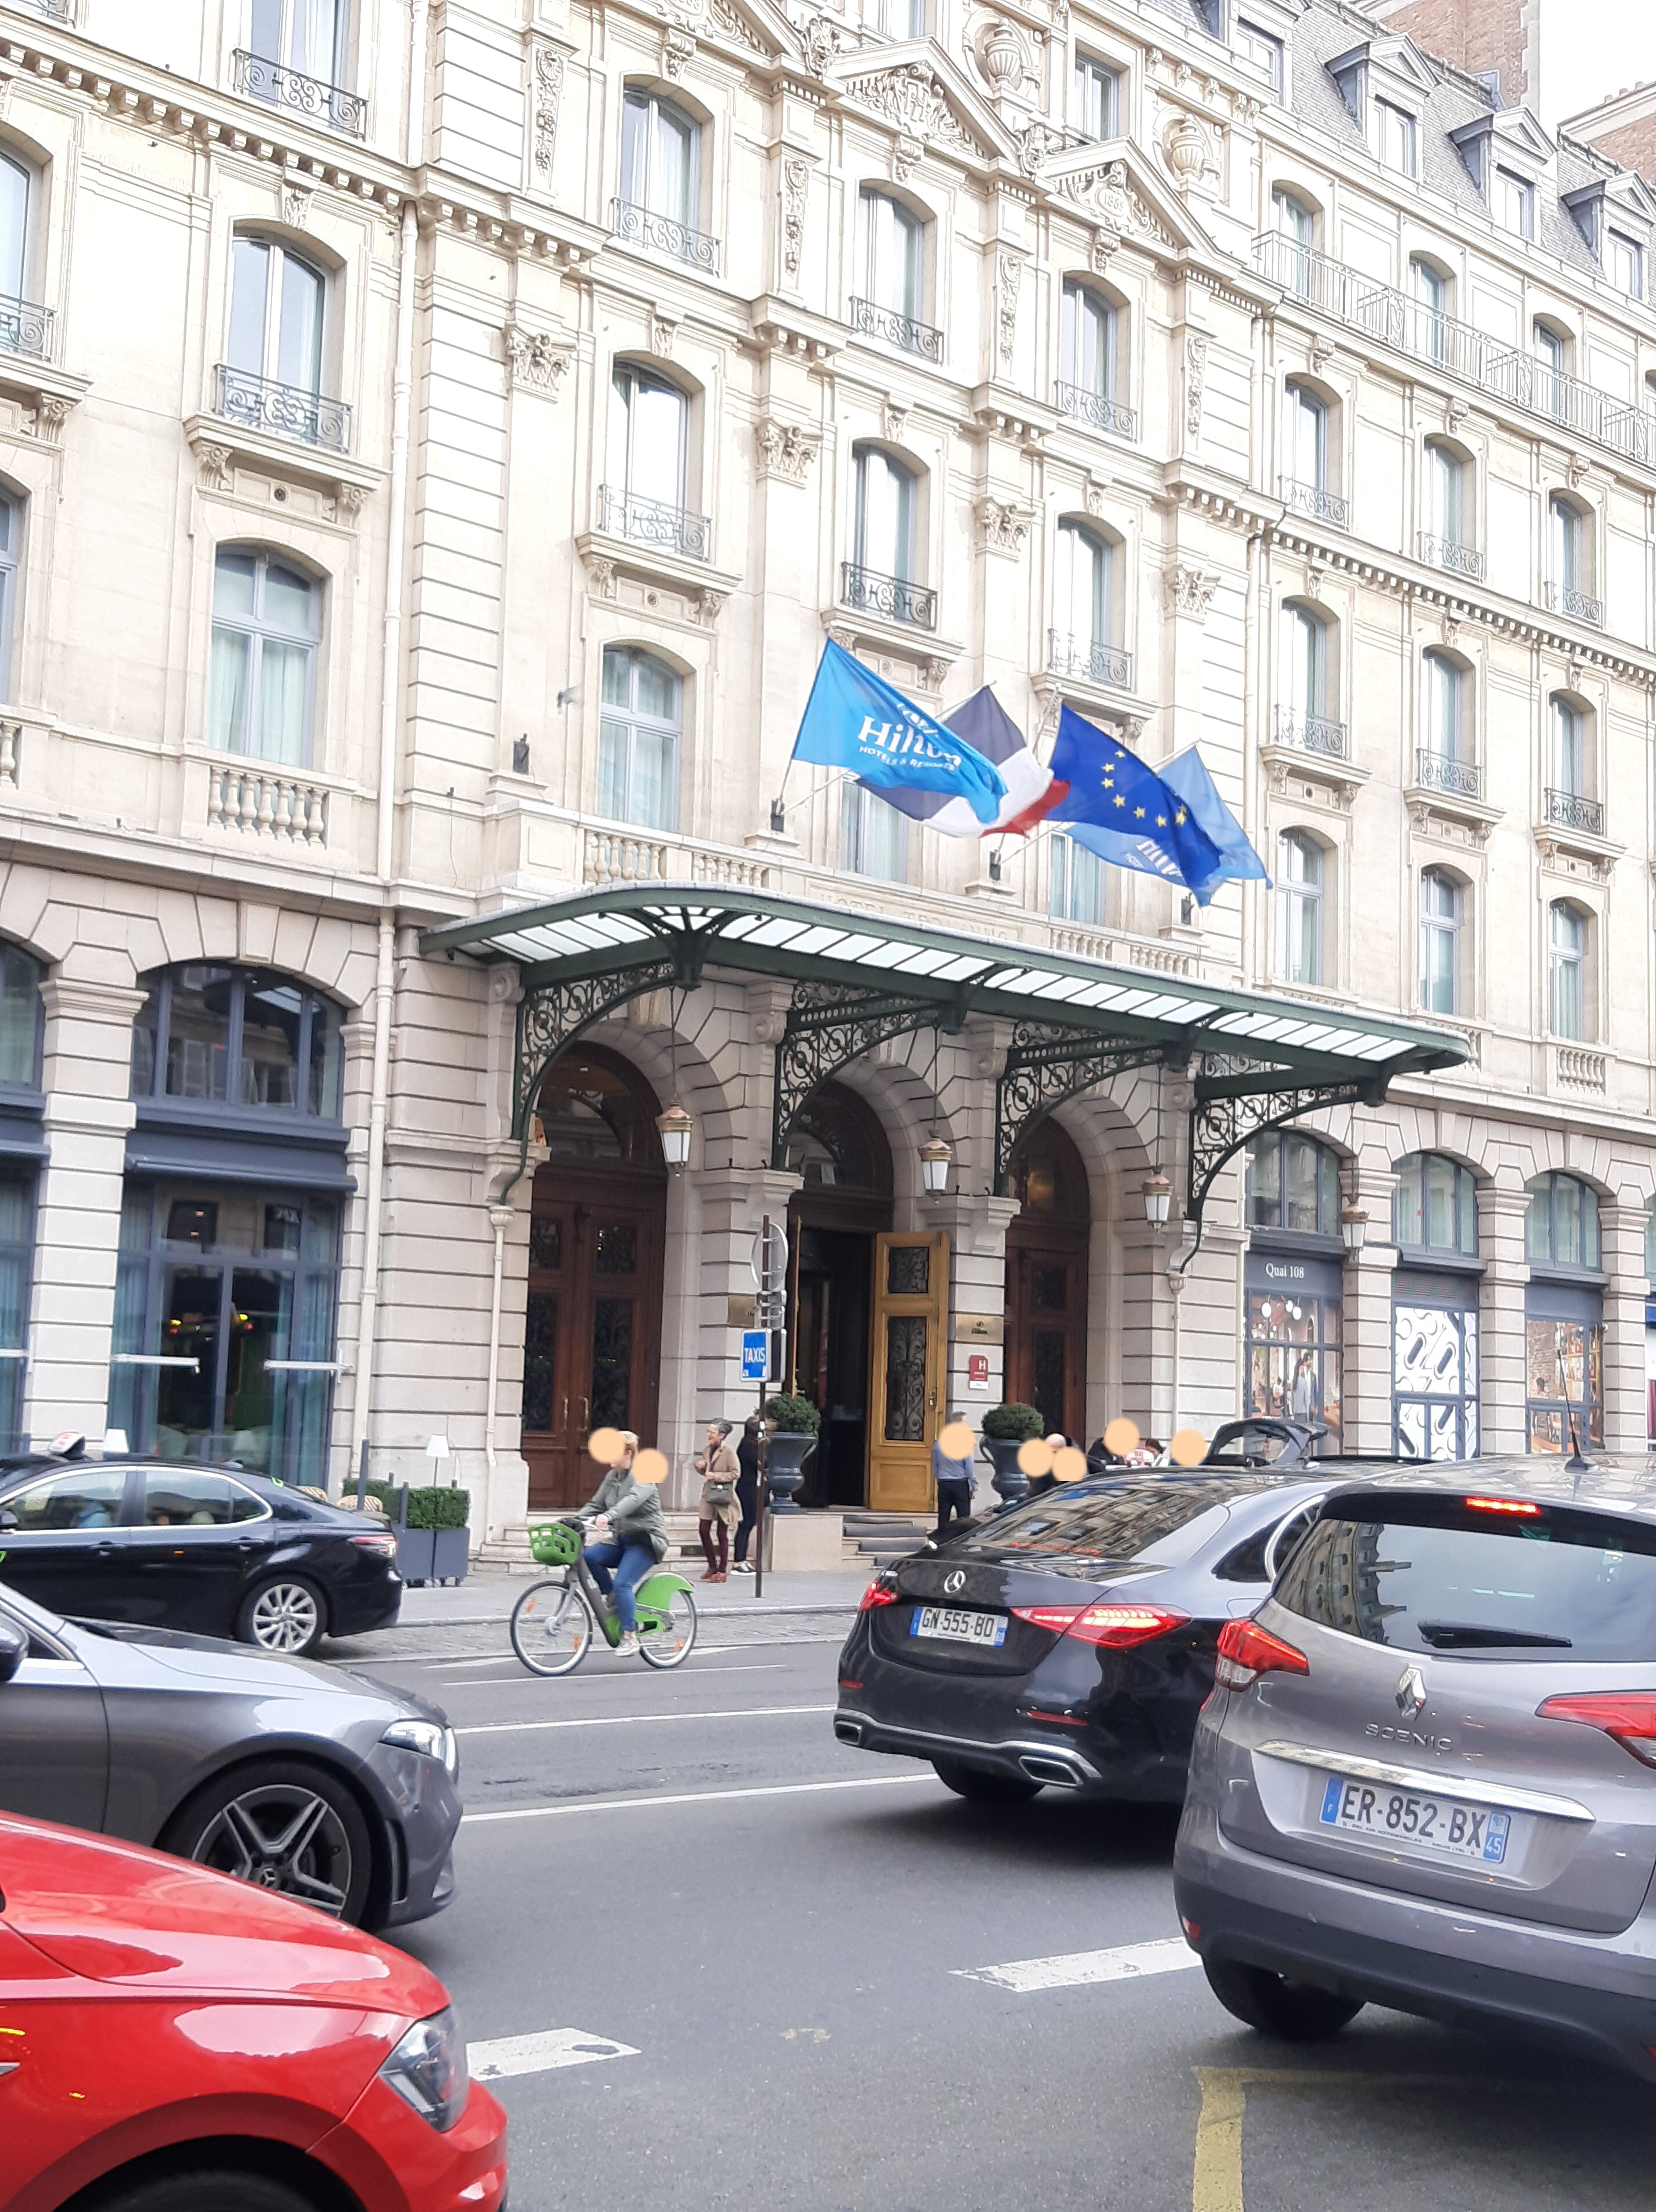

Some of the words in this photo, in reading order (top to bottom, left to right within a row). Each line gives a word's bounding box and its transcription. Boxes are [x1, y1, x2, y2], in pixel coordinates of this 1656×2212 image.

[1266, 1263, 1287, 1278] Quai
[1290, 1265, 1305, 1279] 108
[744, 1346, 765, 1363] TAXIS
[978, 1359, 986, 1370] H
[1365, 1722, 1452, 1751] SCENIC
[1341, 1784, 1486, 1849] ER-852-BX
[1485, 1836, 1501, 1854] 45
